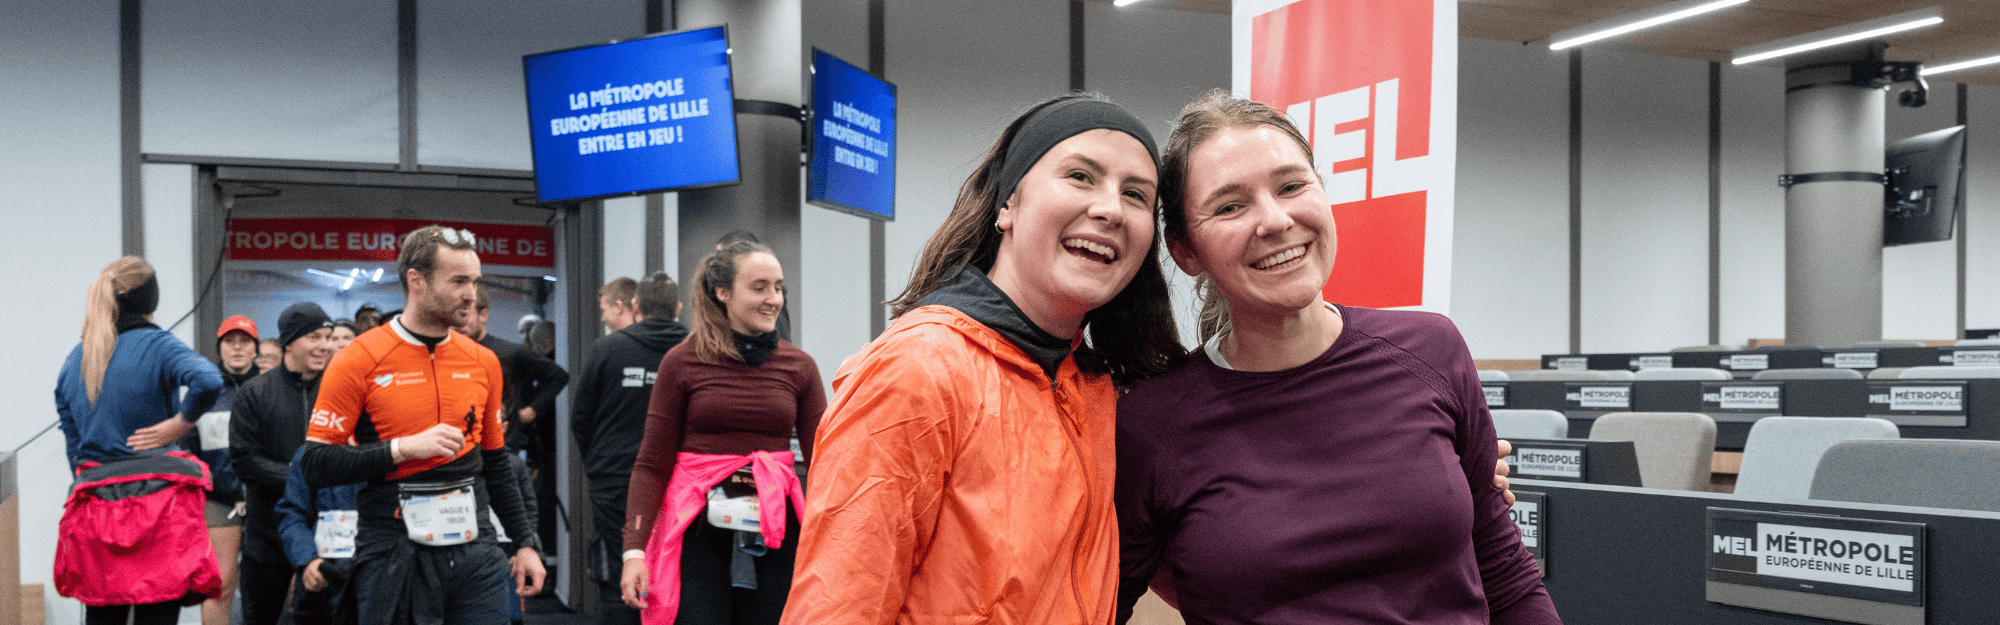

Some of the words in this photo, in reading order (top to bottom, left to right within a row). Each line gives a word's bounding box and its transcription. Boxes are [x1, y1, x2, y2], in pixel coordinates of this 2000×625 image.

[569, 92, 588, 111] LA
[590, 77, 685, 108] MÉTROPOLE
[551, 106, 646, 136] EUROPÉENNE
[648, 103, 668, 123] DE
[670, 98, 709, 120] LILLE
[578, 133, 625, 155] ENTRE
[626, 130, 646, 149] EN
[648, 126, 675, 146] JEU
[516, 239, 548, 257] DE
[1725, 389, 1779, 399] MÉTROPOLE
[1895, 389, 1962, 400] MÉTROPOLE
[1522, 452, 1581, 465] MÉTROPOLE
[1713, 534, 1757, 557] MEL
[1766, 531, 1914, 565] MÉTROPOLE
[1766, 555, 1850, 574] EUROPÉENNE
[1855, 564, 1872, 576] DE
[1877, 567, 1914, 581] LILLE
